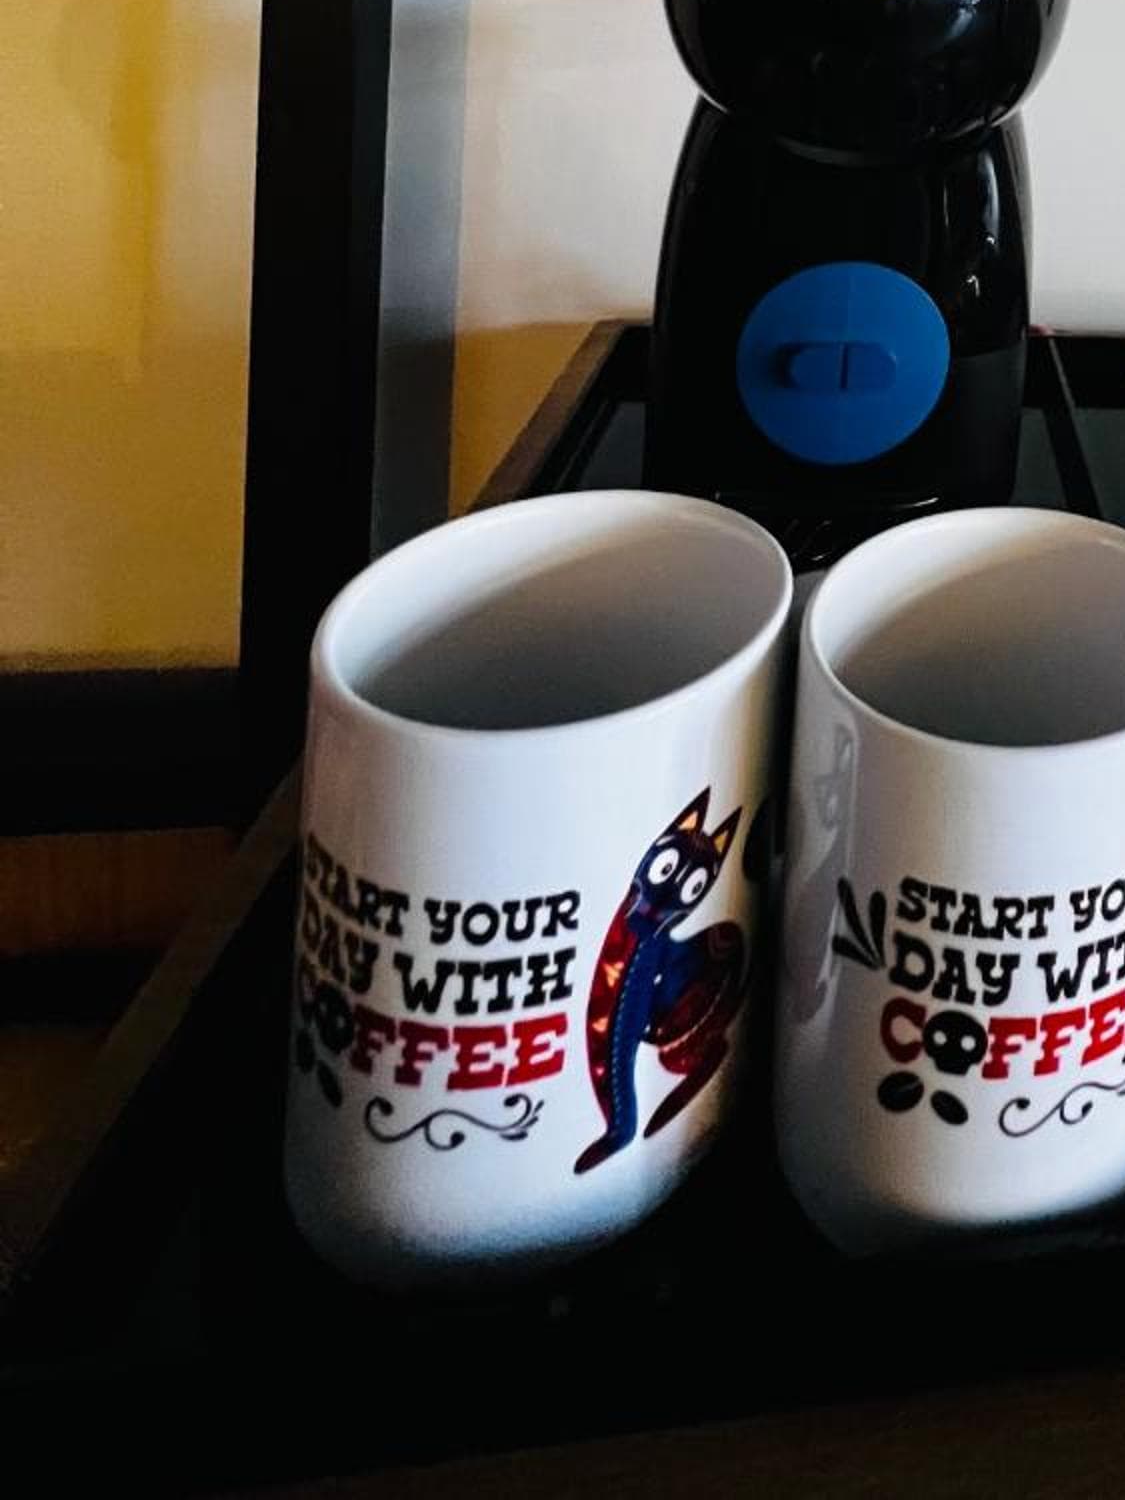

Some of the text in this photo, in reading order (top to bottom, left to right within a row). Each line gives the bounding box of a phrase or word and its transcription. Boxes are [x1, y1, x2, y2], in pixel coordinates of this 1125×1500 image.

[425, 890, 580, 945] YOUR
[896, 876, 1054, 940] START
[394, 947, 577, 1015] WITH
[889, 930, 1020, 1007] DAY
